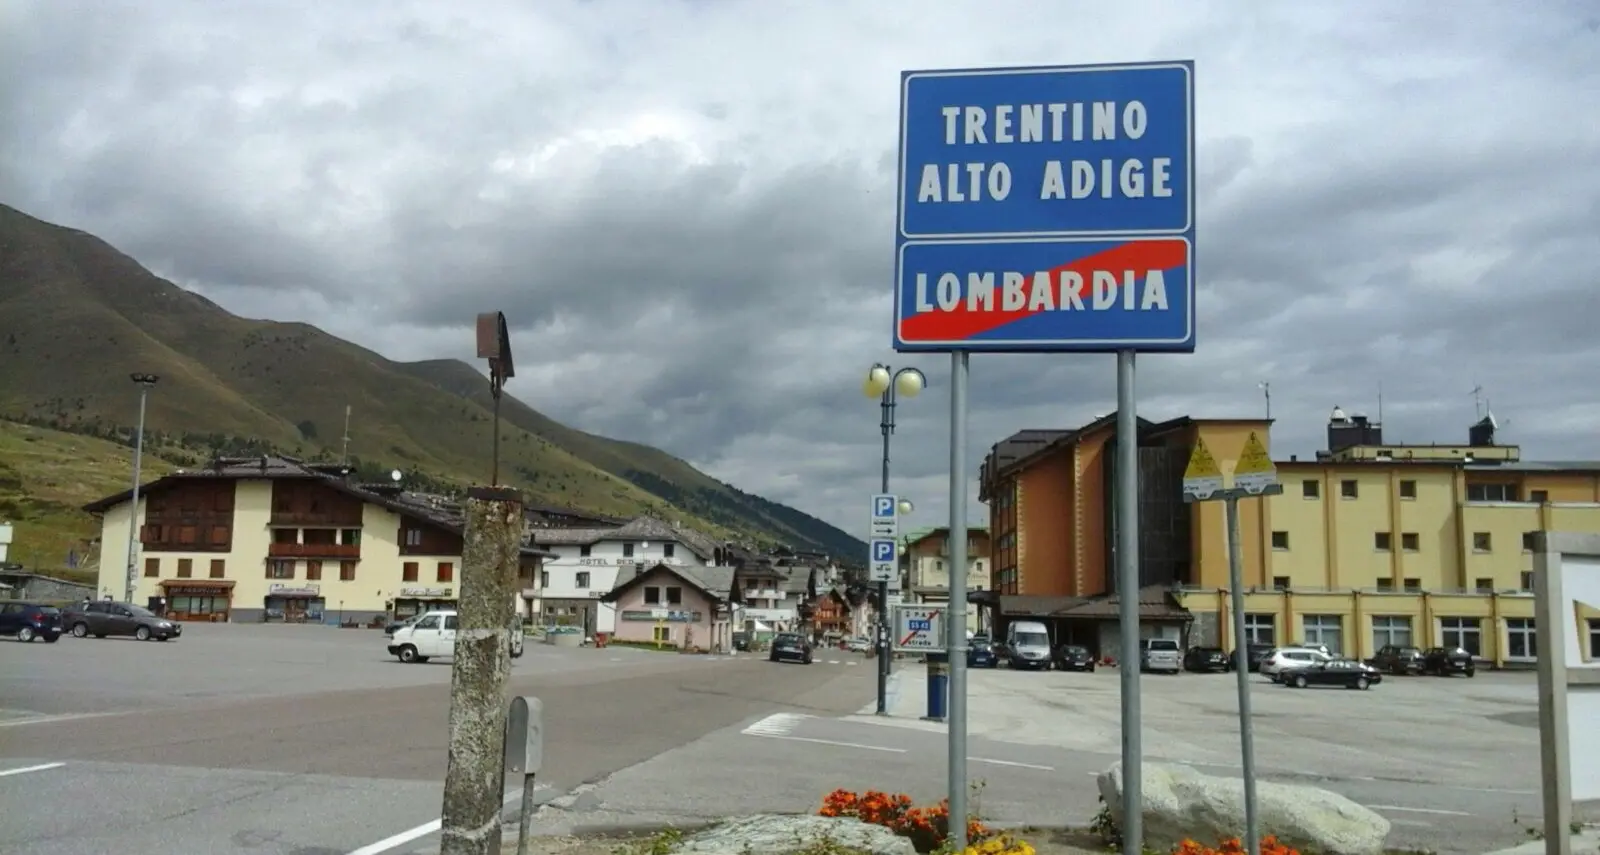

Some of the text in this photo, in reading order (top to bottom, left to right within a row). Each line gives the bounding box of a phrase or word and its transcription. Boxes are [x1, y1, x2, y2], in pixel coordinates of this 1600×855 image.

[942, 100, 1147, 145] TRENTINO
[918, 157, 1172, 202] ALTO ADIGE
[915, 270, 1169, 312] LOMBARDIA
[878, 499, 891, 515] P
[878, 543, 890, 559] P
